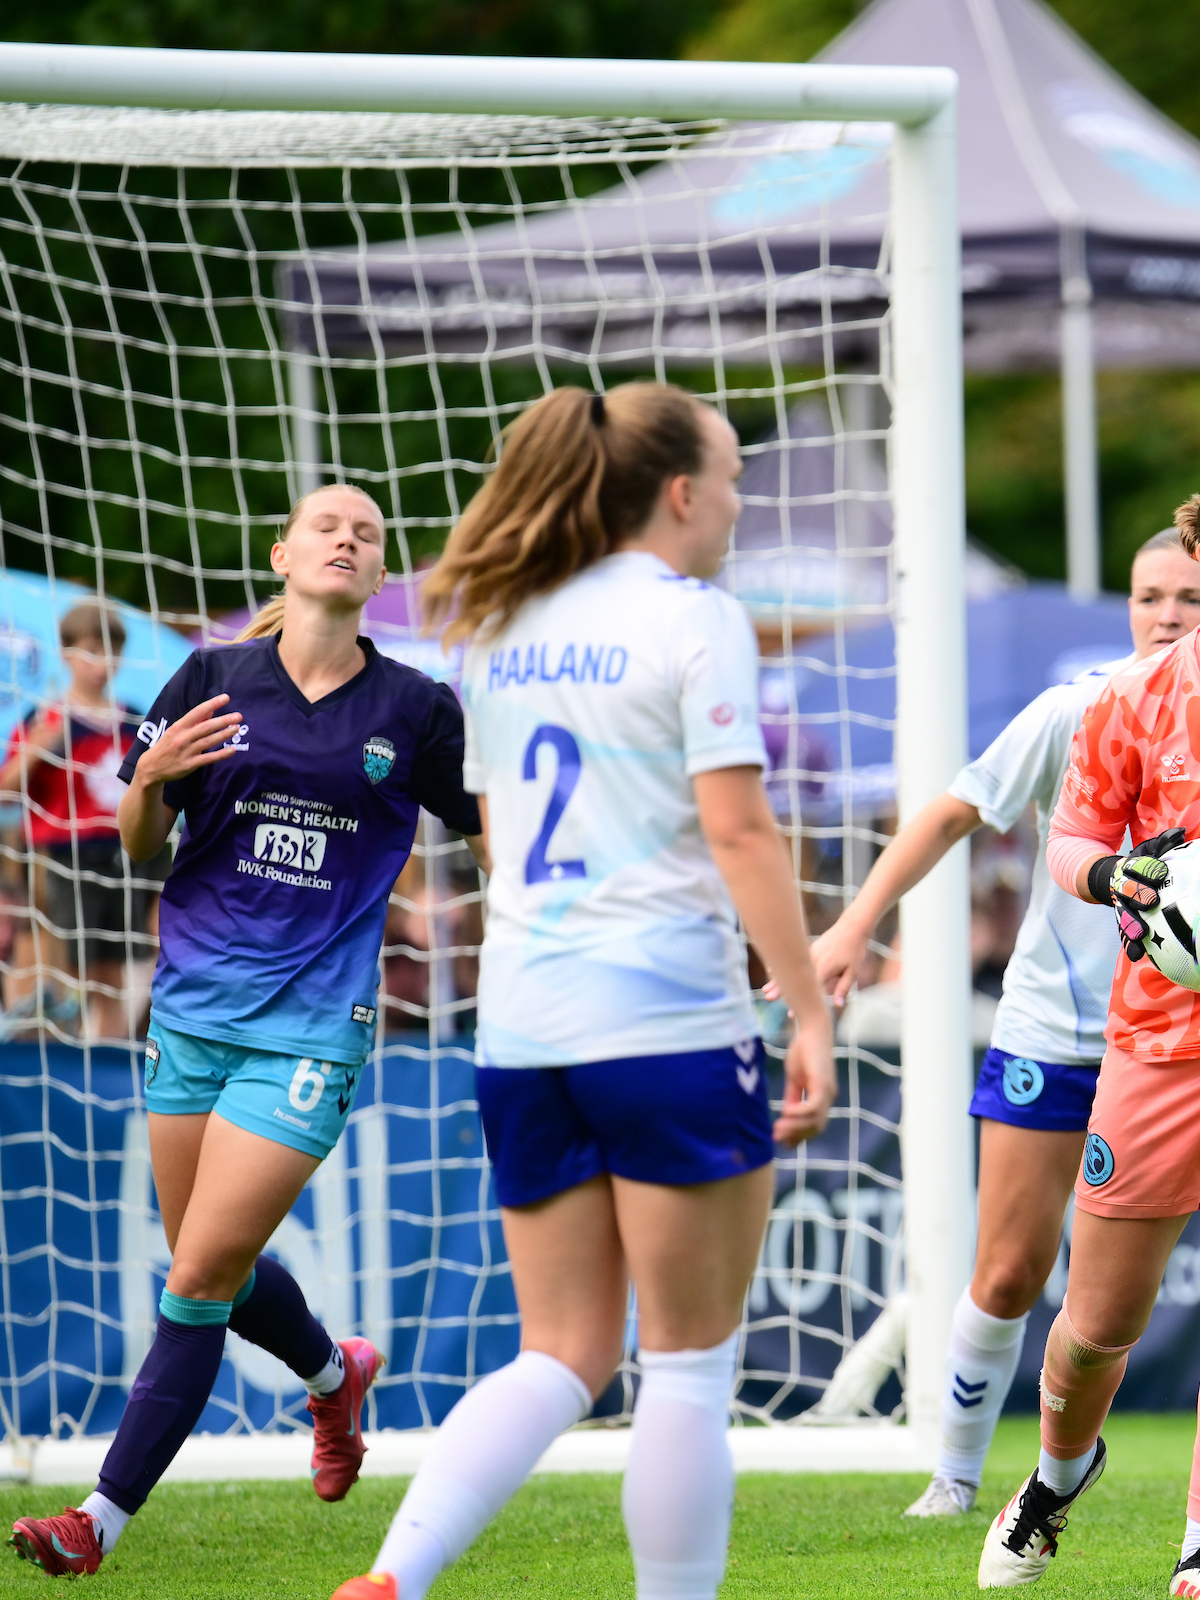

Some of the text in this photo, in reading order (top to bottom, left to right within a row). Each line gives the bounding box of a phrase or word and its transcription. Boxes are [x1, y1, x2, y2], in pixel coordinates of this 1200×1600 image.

[488, 643, 629, 692] HAALAND
[365, 744, 396, 761] TIDES
[1161, 773, 1190, 783] hummel
[234, 800, 359, 833] WOMEN'S HEALTH
[261, 792, 334, 812] PROUD SUPPORTER
[522, 723, 587, 885] 2
[236, 859, 332, 891] IWK Foundation
[288, 1057, 333, 1112] 6
[272, 1107, 312, 1131] hummel
